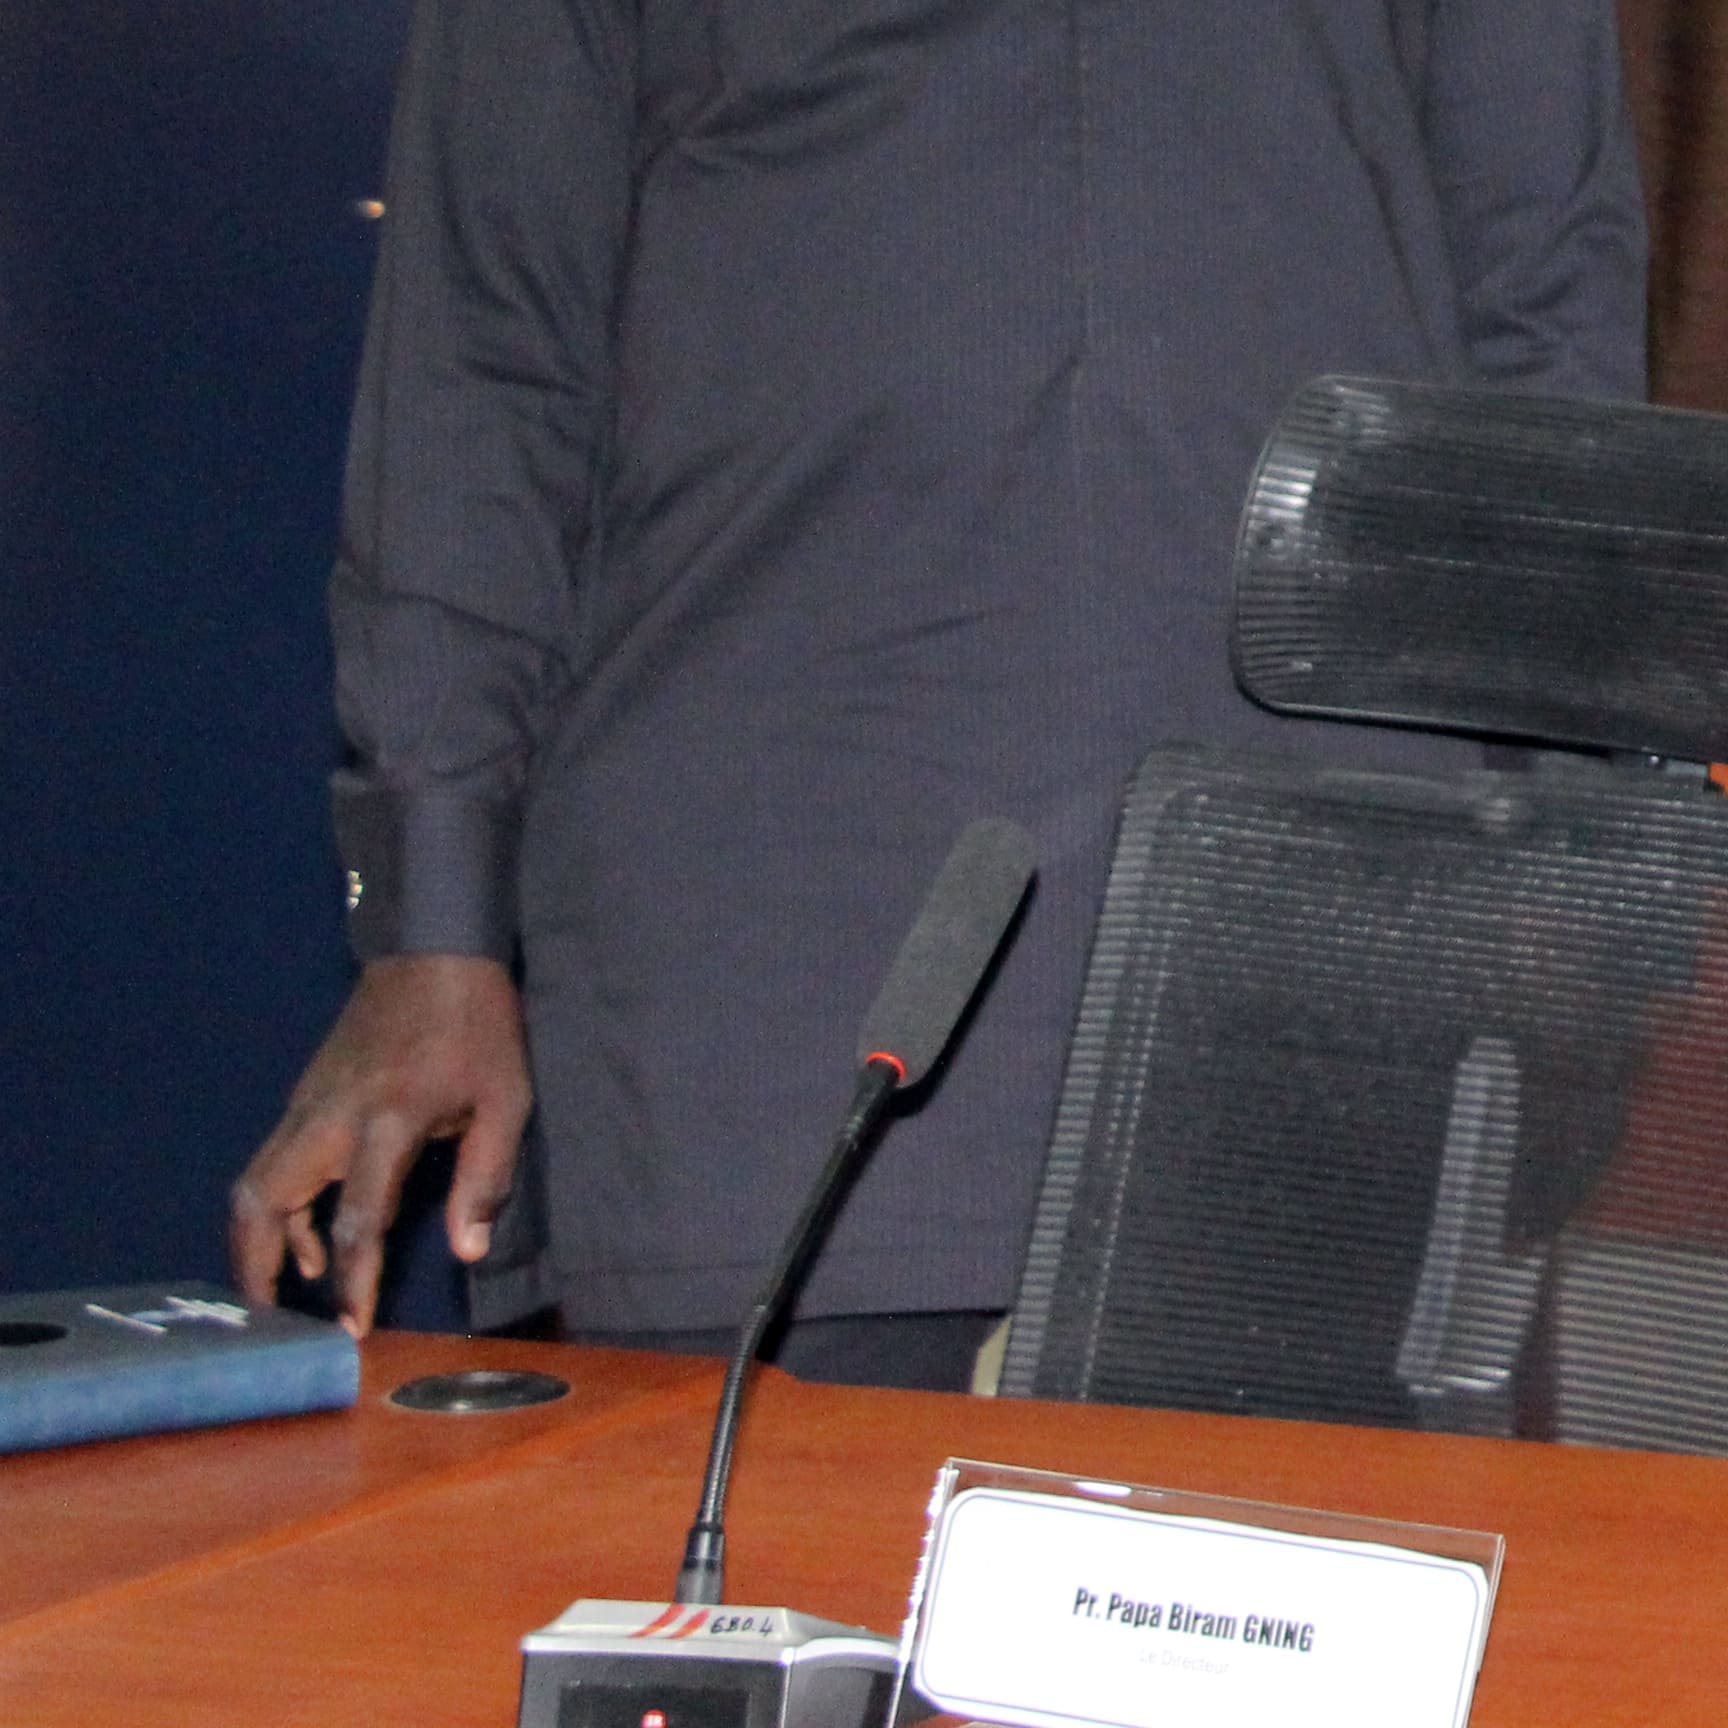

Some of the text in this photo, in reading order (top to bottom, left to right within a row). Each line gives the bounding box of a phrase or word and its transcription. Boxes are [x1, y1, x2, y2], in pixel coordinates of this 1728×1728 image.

[1106, 1592, 1163, 1628] Papa
[1167, 1602, 1237, 1640] Biram
[1242, 1613, 1315, 1652] GNING
